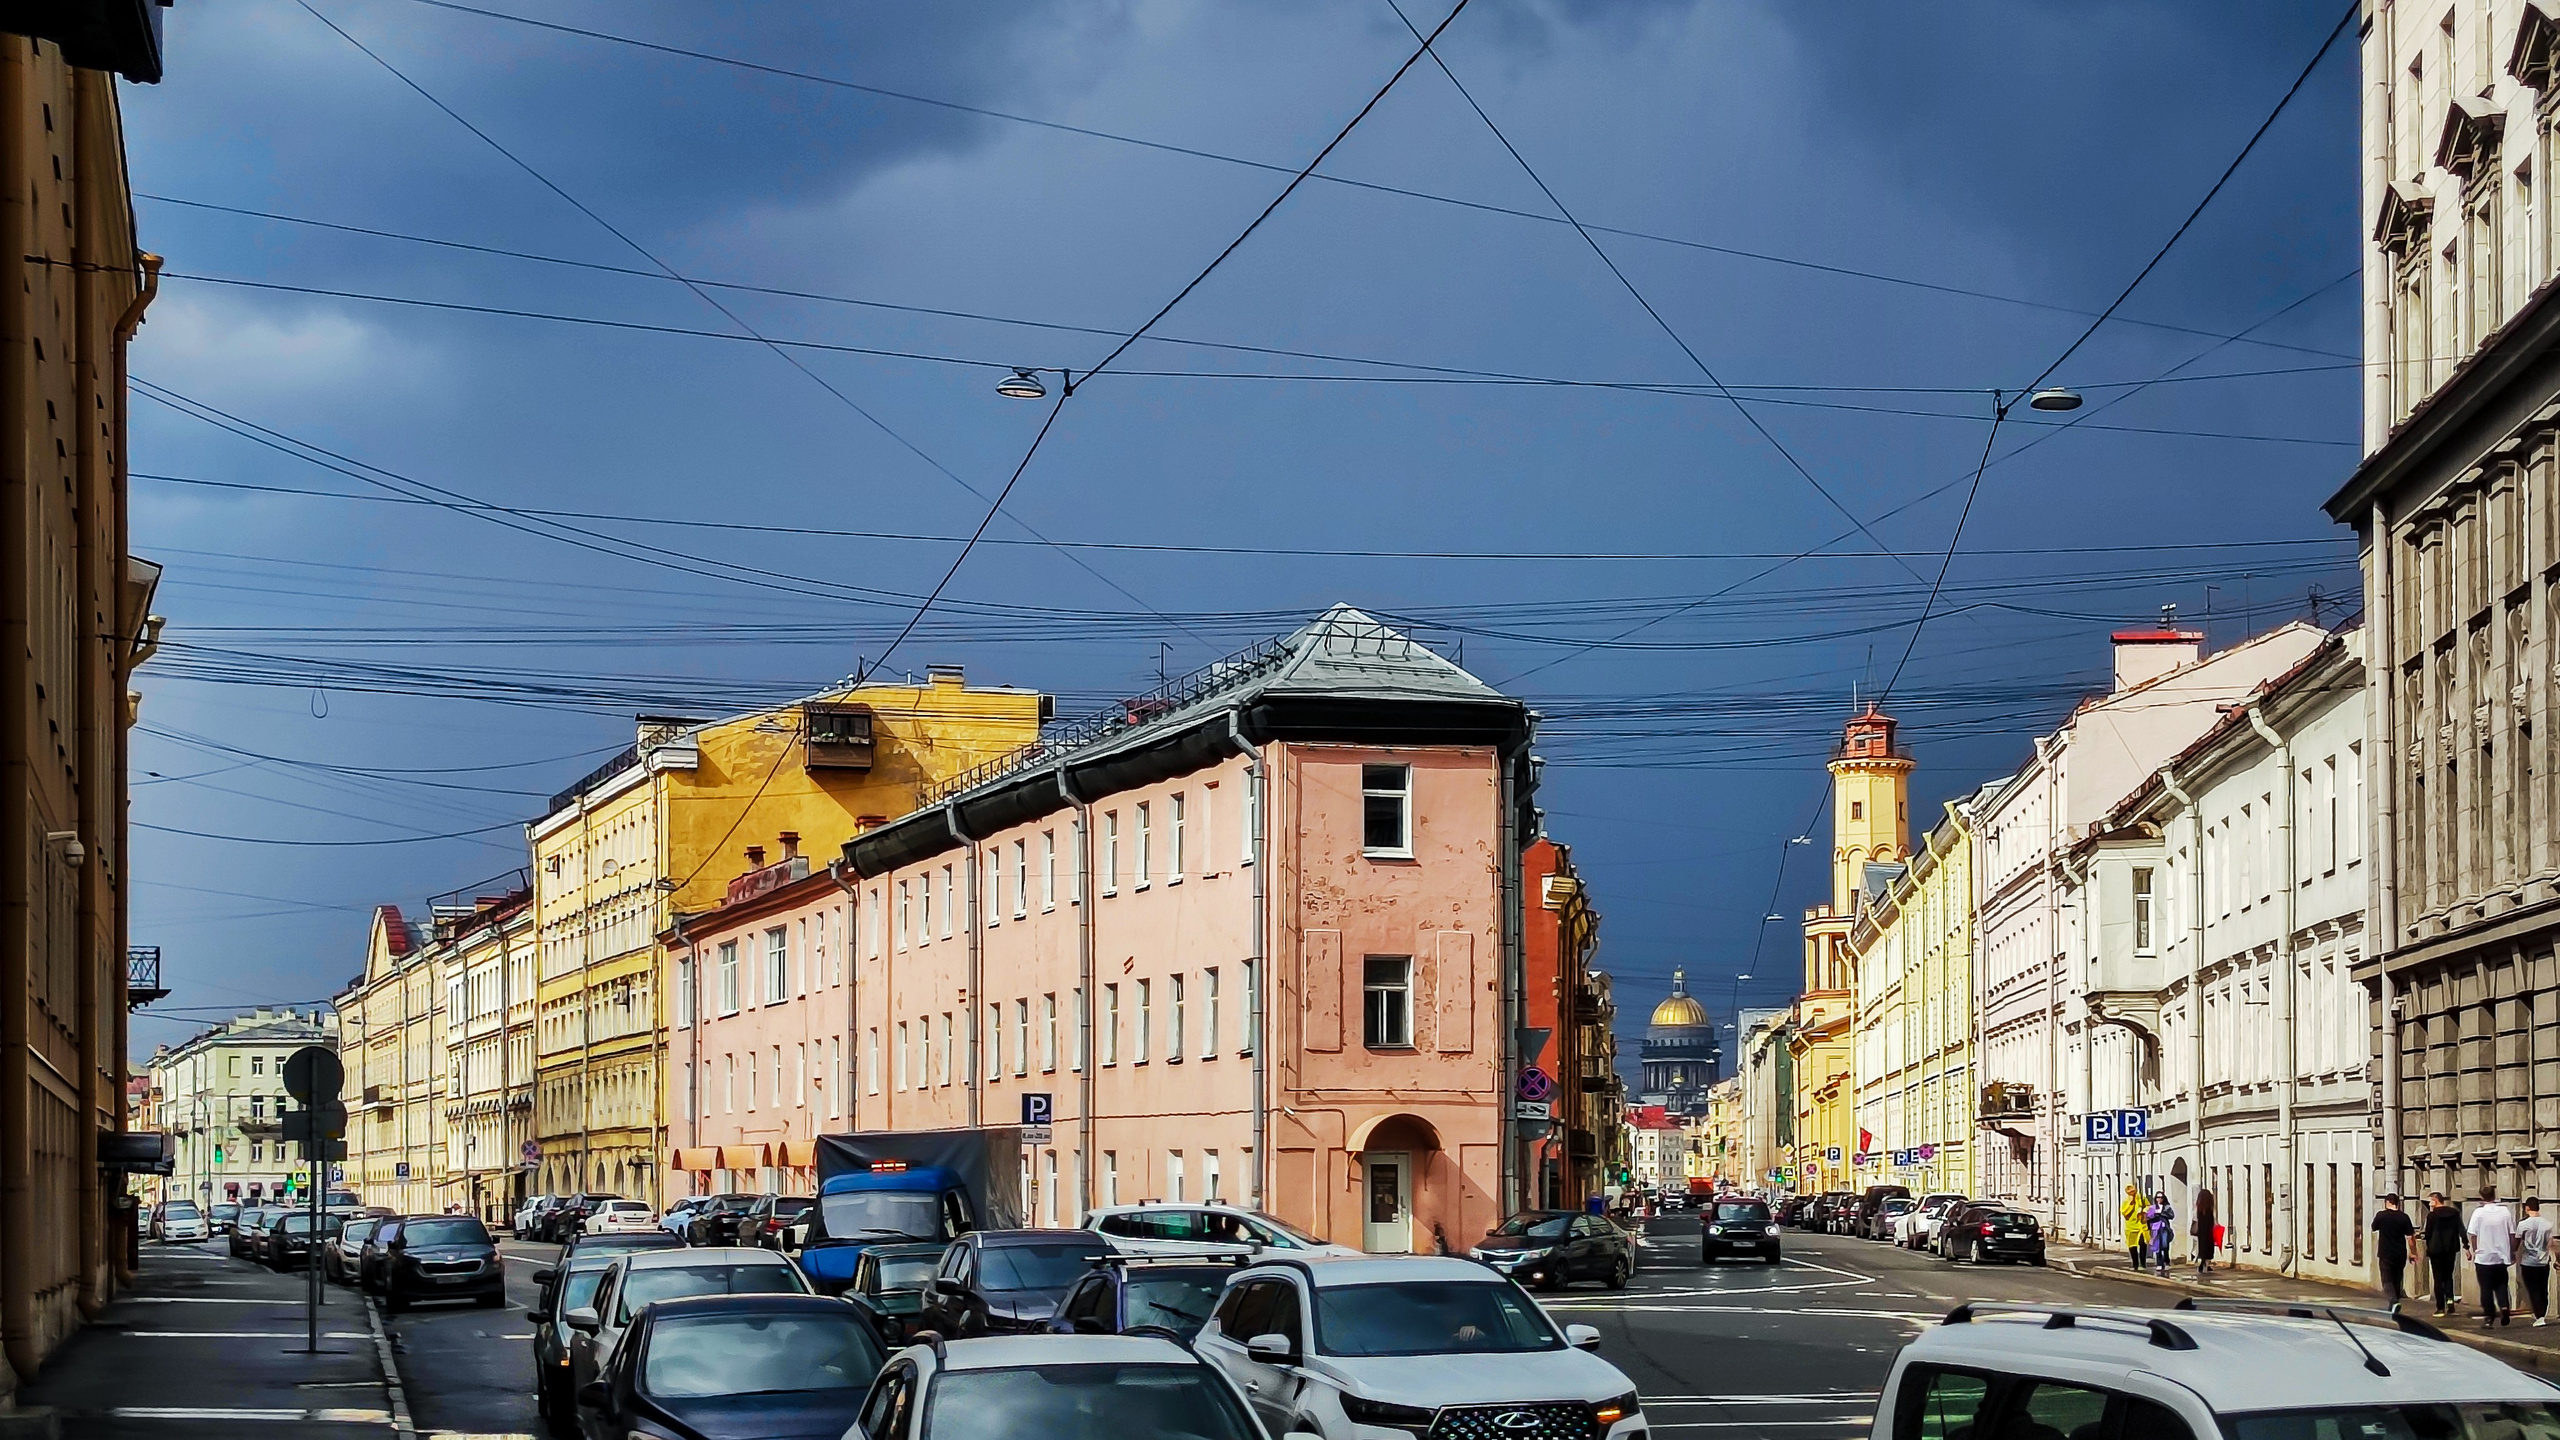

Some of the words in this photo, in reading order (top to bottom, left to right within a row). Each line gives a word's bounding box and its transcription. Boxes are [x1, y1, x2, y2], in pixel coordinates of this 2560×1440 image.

[1030, 1096, 1047, 1121] P
[2093, 1118, 2109, 1139] P
[2125, 1112, 2141, 1136] P
[1832, 1149, 1839, 1159] P
[1897, 1153, 1906, 1165] P
[398, 1164, 407, 1175] P
